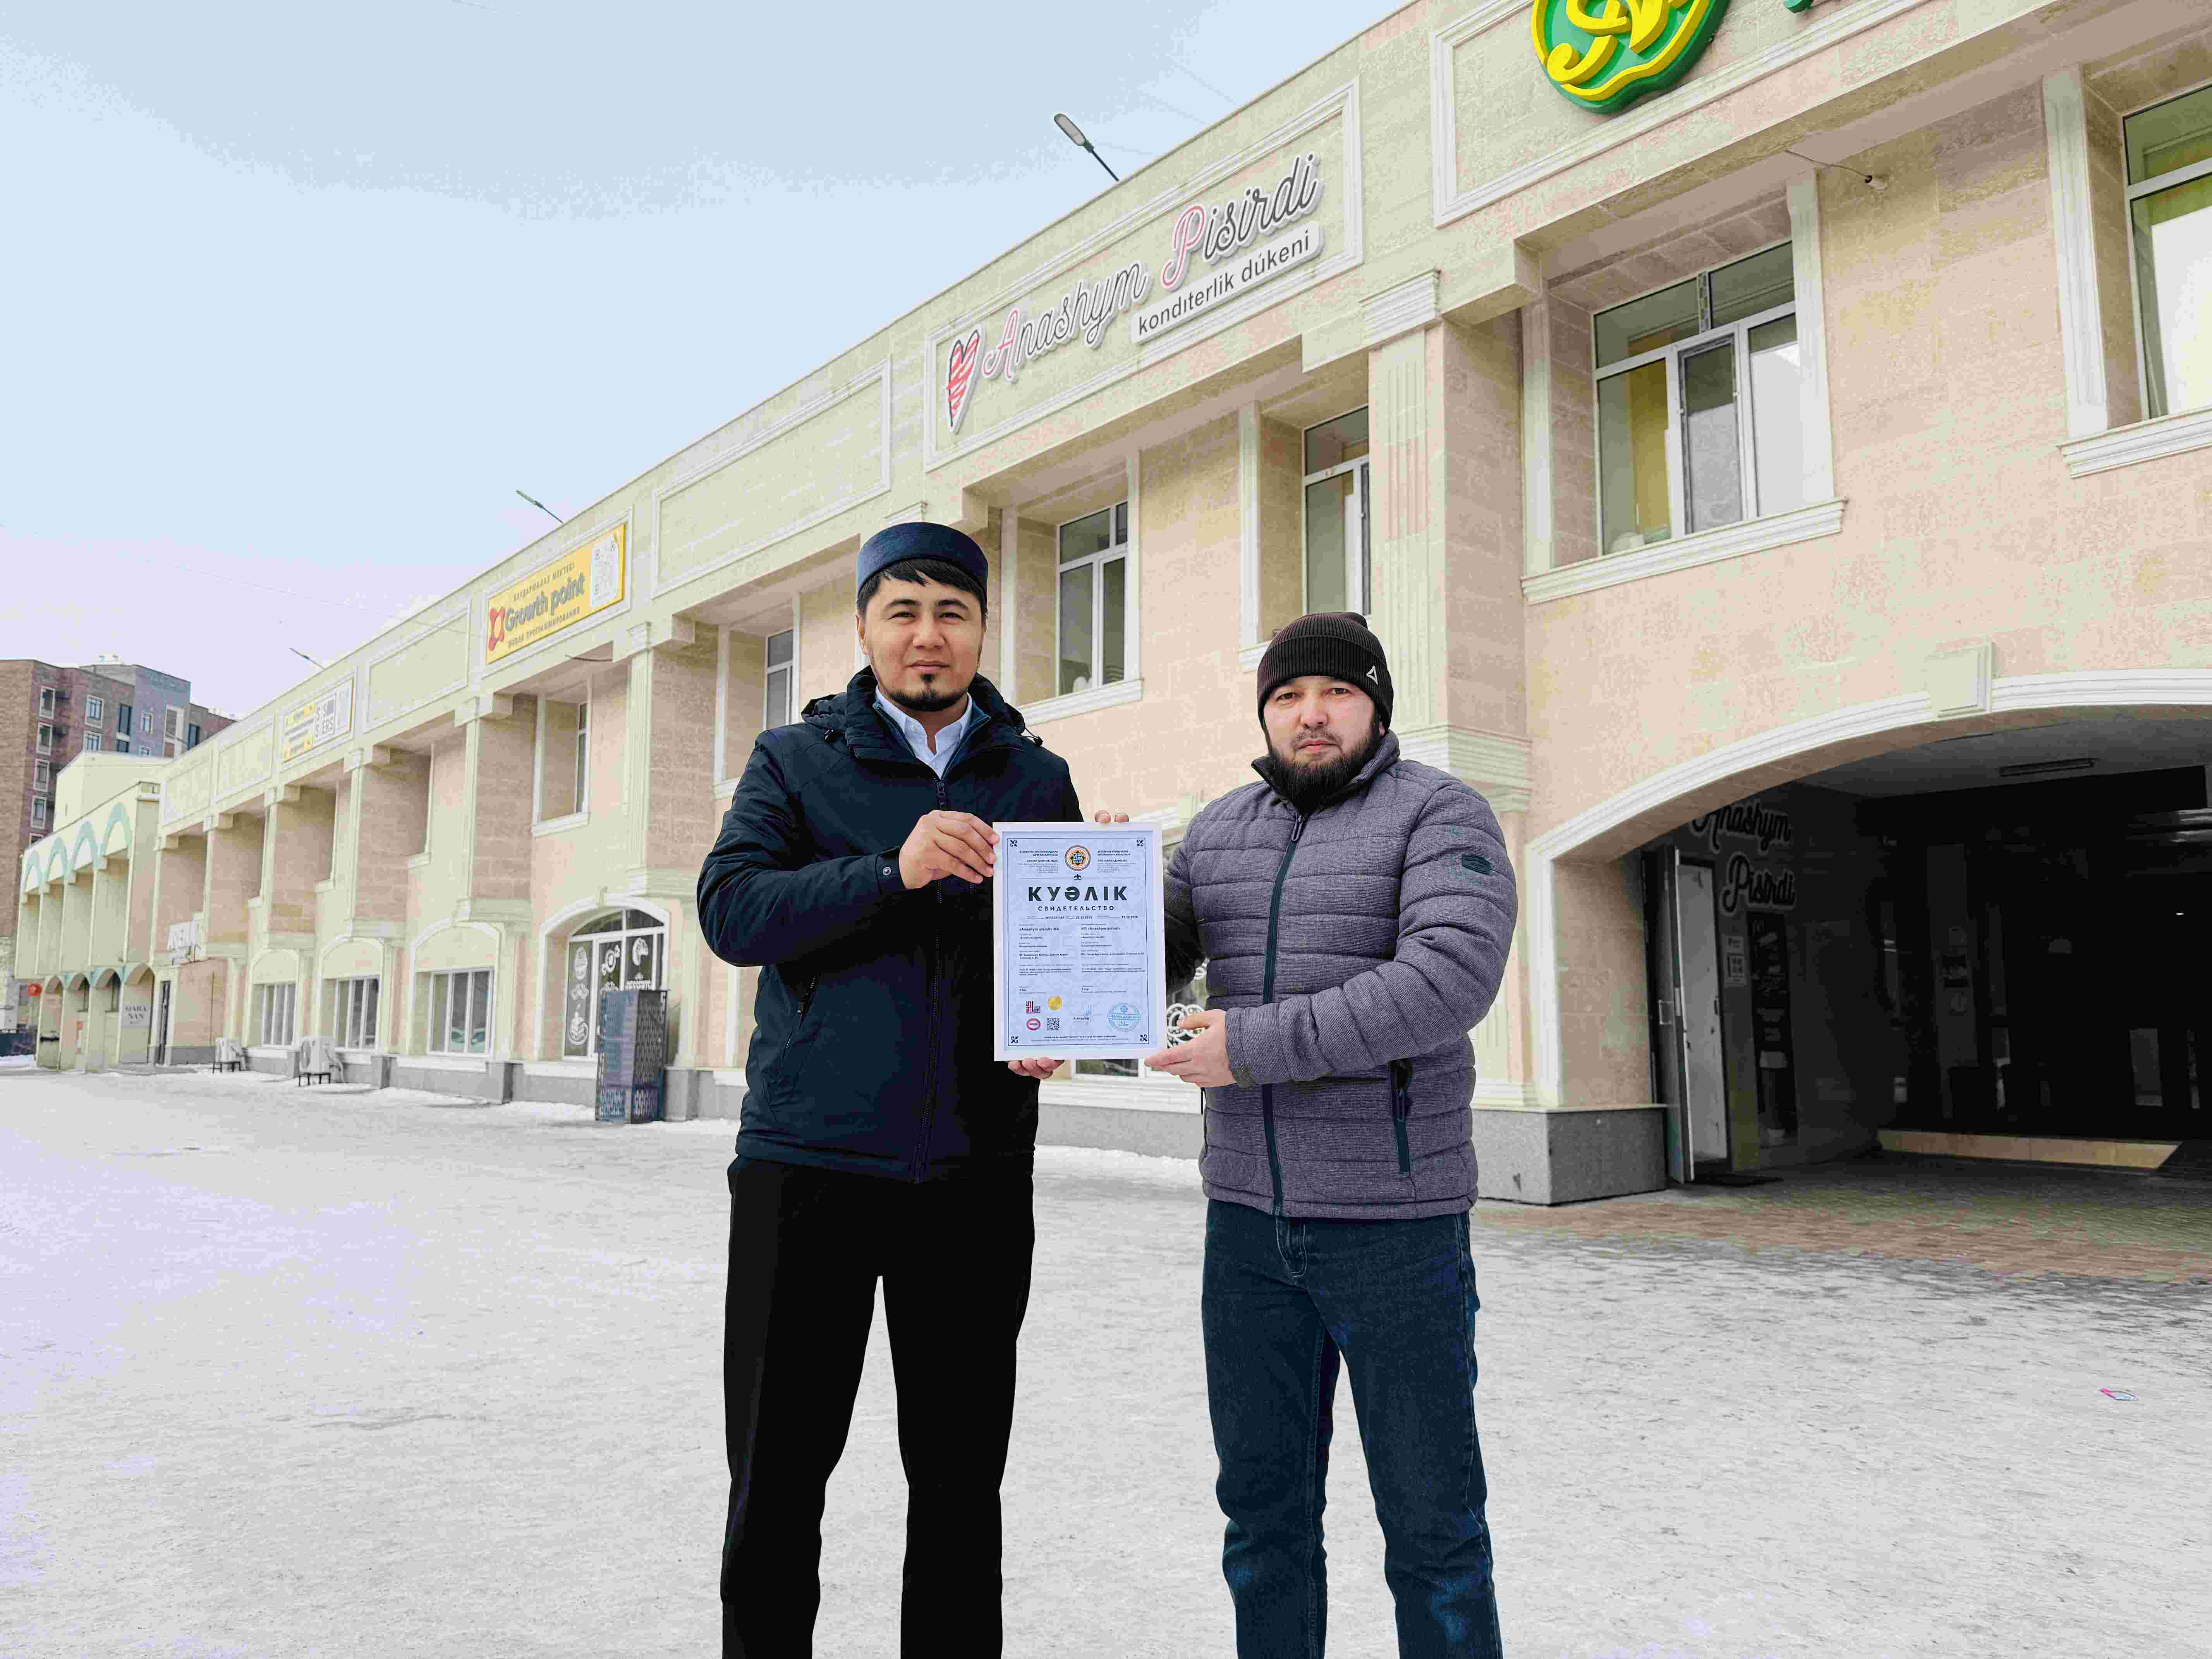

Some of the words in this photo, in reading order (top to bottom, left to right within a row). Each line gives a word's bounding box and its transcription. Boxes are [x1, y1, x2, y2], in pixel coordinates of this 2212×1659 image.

[982, 263, 1147, 379] Anashym
[1162, 153, 1317, 286] Pisirdi
[505, 591, 549, 632] Growth
[550, 572, 585, 616] point
[1028, 886, 1128, 902] КУӘЛІК
[1723, 854, 1796, 913] Pisirdi
